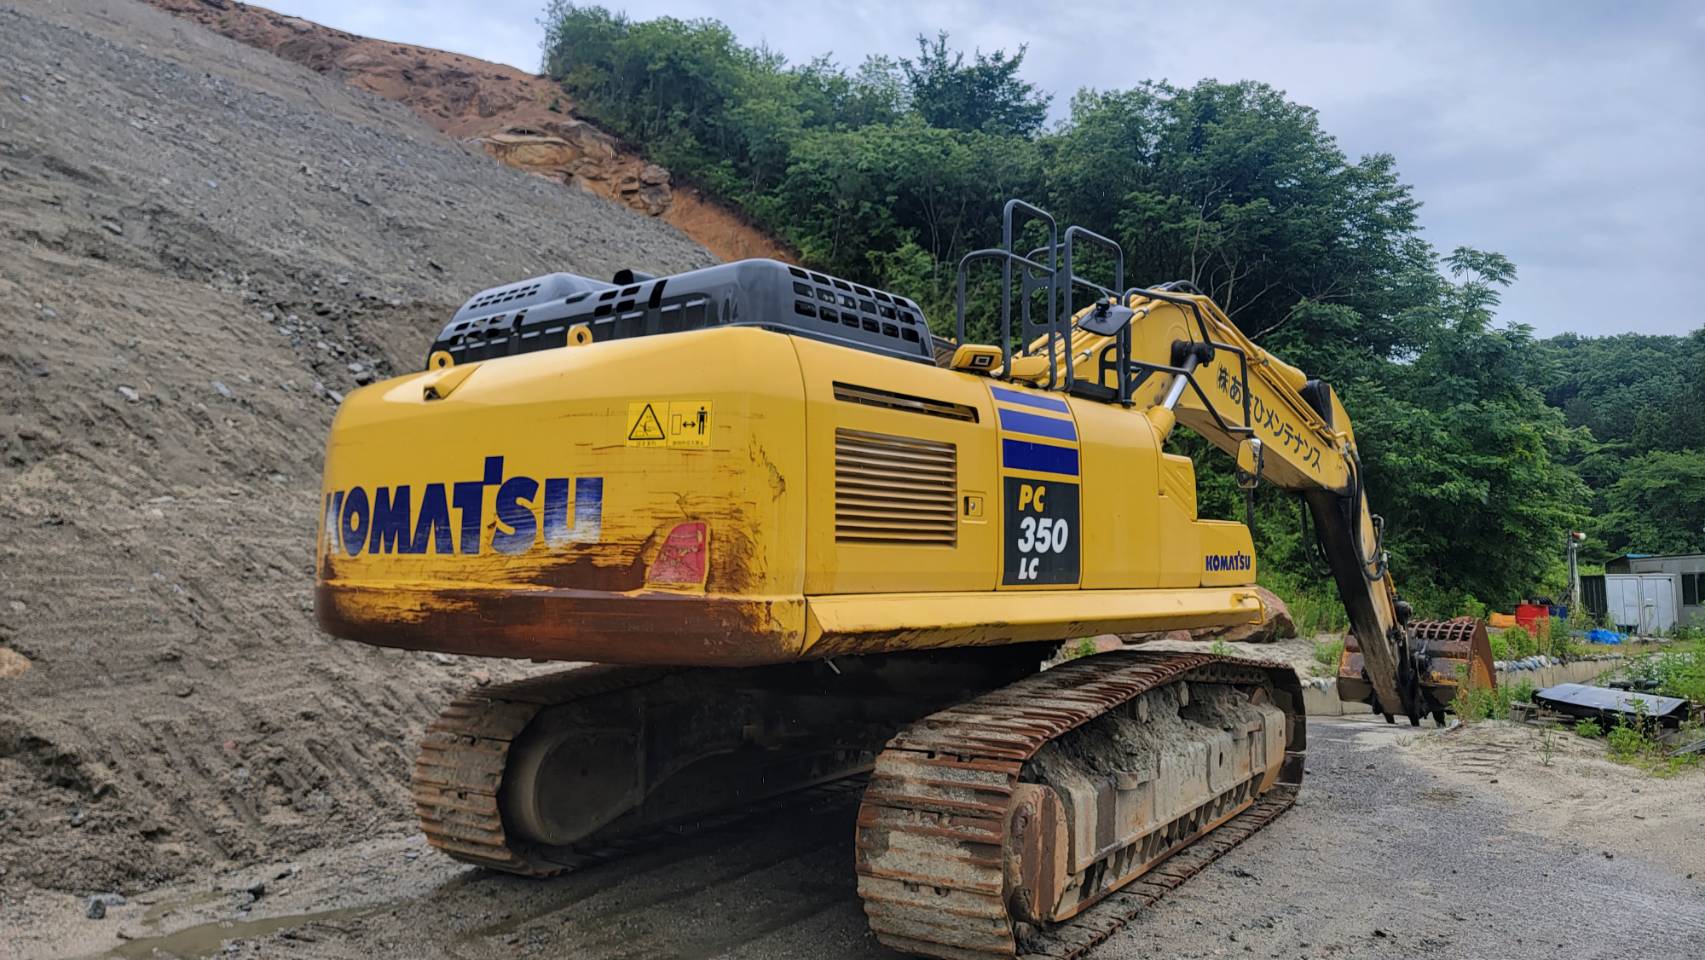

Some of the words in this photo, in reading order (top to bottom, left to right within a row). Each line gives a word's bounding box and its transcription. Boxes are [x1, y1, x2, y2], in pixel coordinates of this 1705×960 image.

[325, 456, 604, 556] KOMATSU
[1018, 484, 1045, 512] PC
[1018, 516, 1068, 553] 350
[1018, 557, 1039, 580] LC
[1205, 550, 1251, 571] KOMATSU
